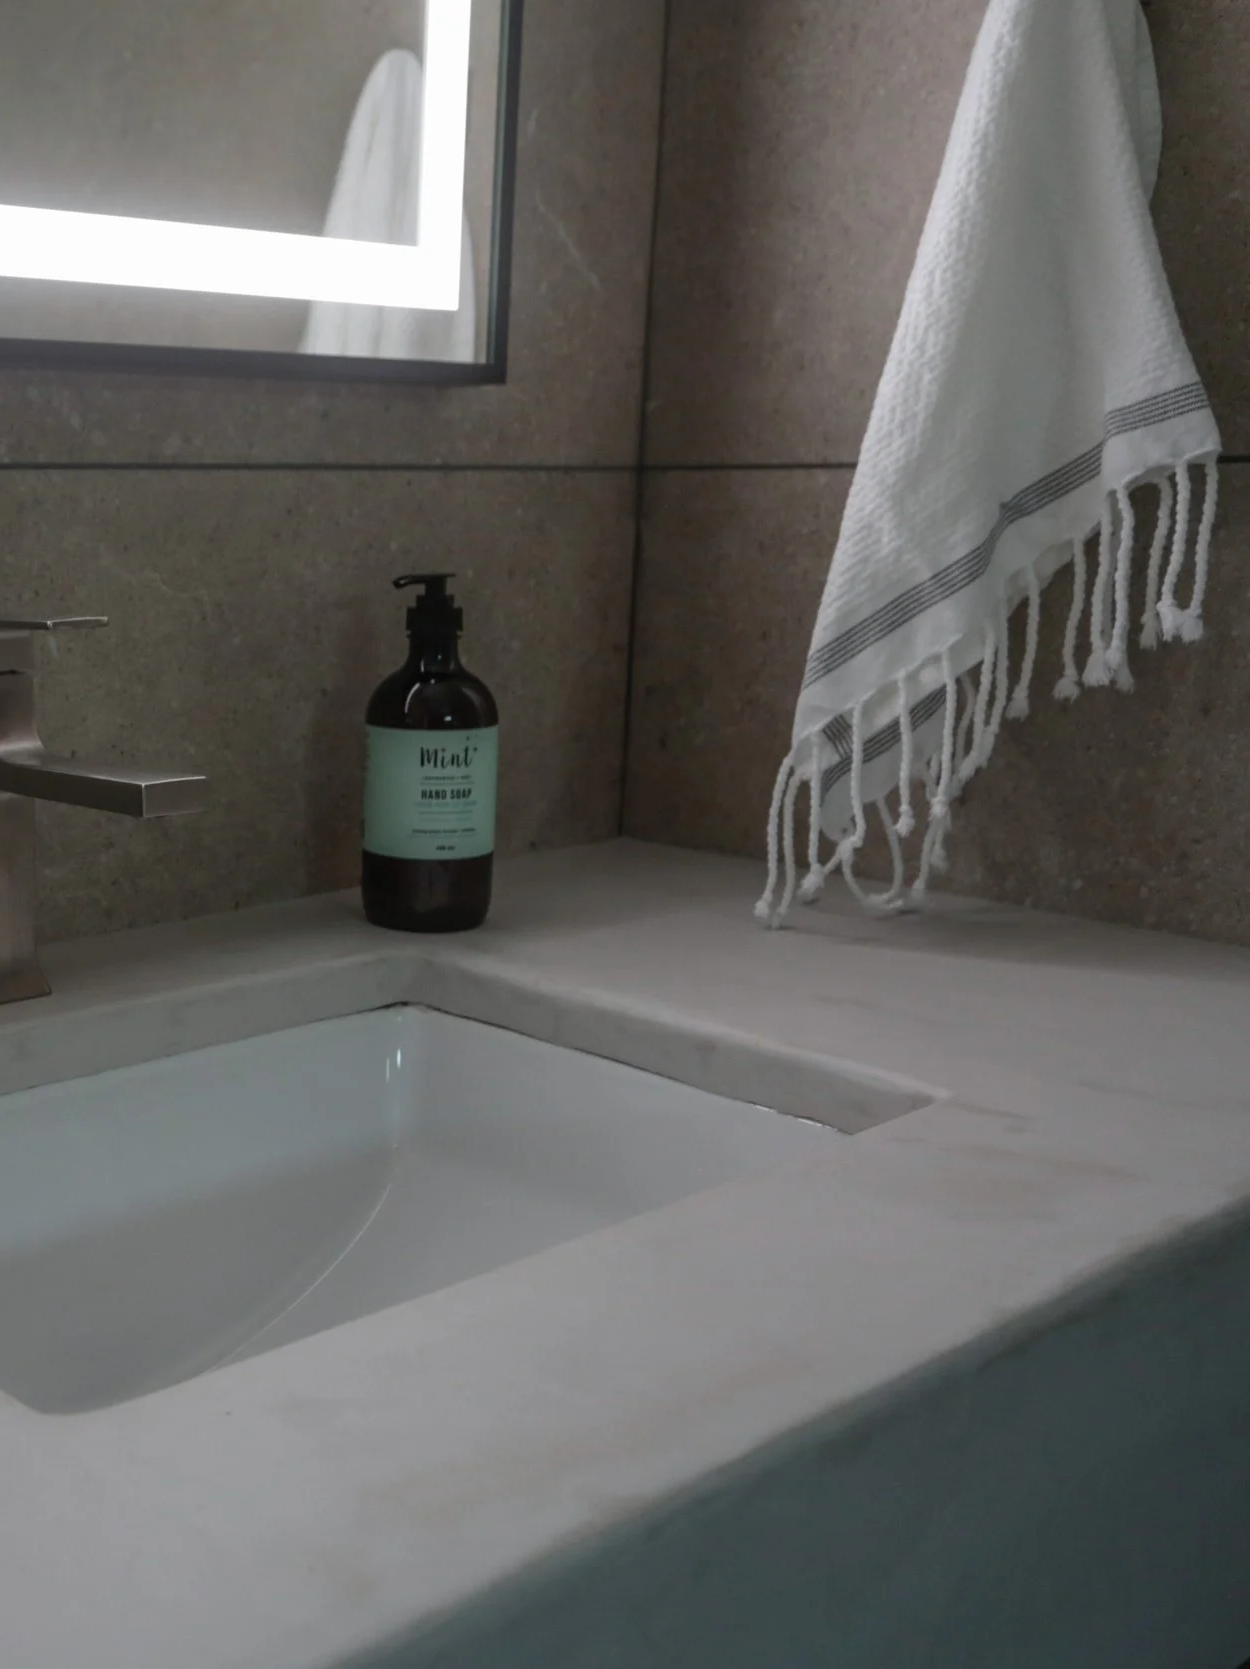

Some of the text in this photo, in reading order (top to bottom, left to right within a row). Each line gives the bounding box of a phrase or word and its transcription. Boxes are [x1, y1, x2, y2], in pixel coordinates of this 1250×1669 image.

[420, 746, 472, 769] Mint
[421, 788, 472, 800] HAND SOAP
